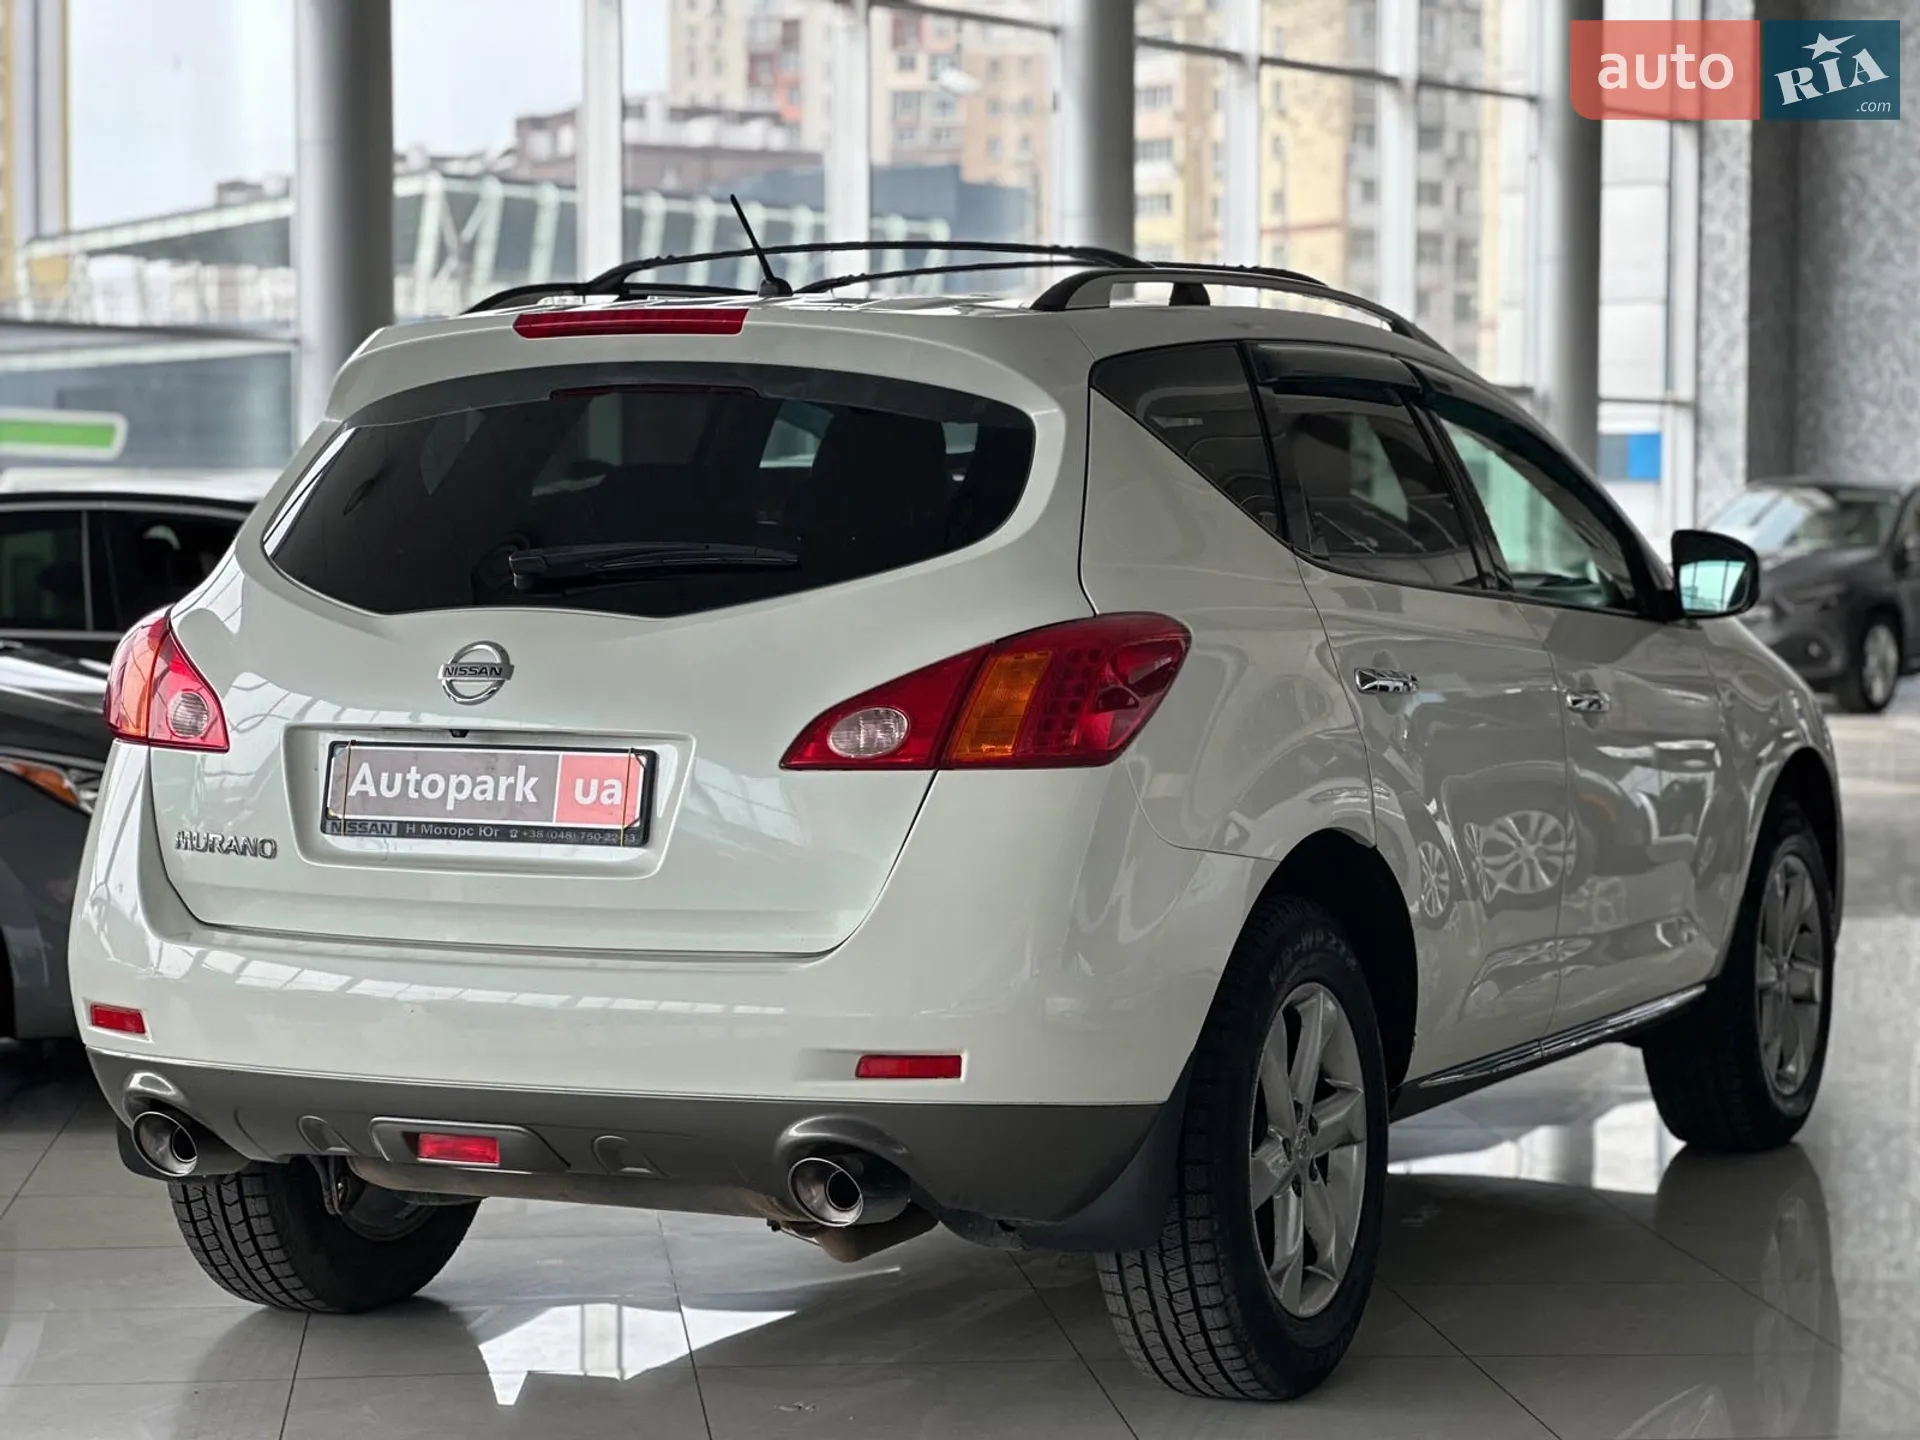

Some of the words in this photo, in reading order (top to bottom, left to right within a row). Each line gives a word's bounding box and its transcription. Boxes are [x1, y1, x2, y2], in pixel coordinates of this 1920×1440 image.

[443, 666, 503, 676] NISSAN
[347, 762, 539, 811] Autopark
[574, 776, 622, 805] ua
[331, 821, 393, 835] NSSAN
[420, 824, 474, 838] Моторс
[478, 825, 499, 838] Юг
[174, 830, 278, 859] MURANO
